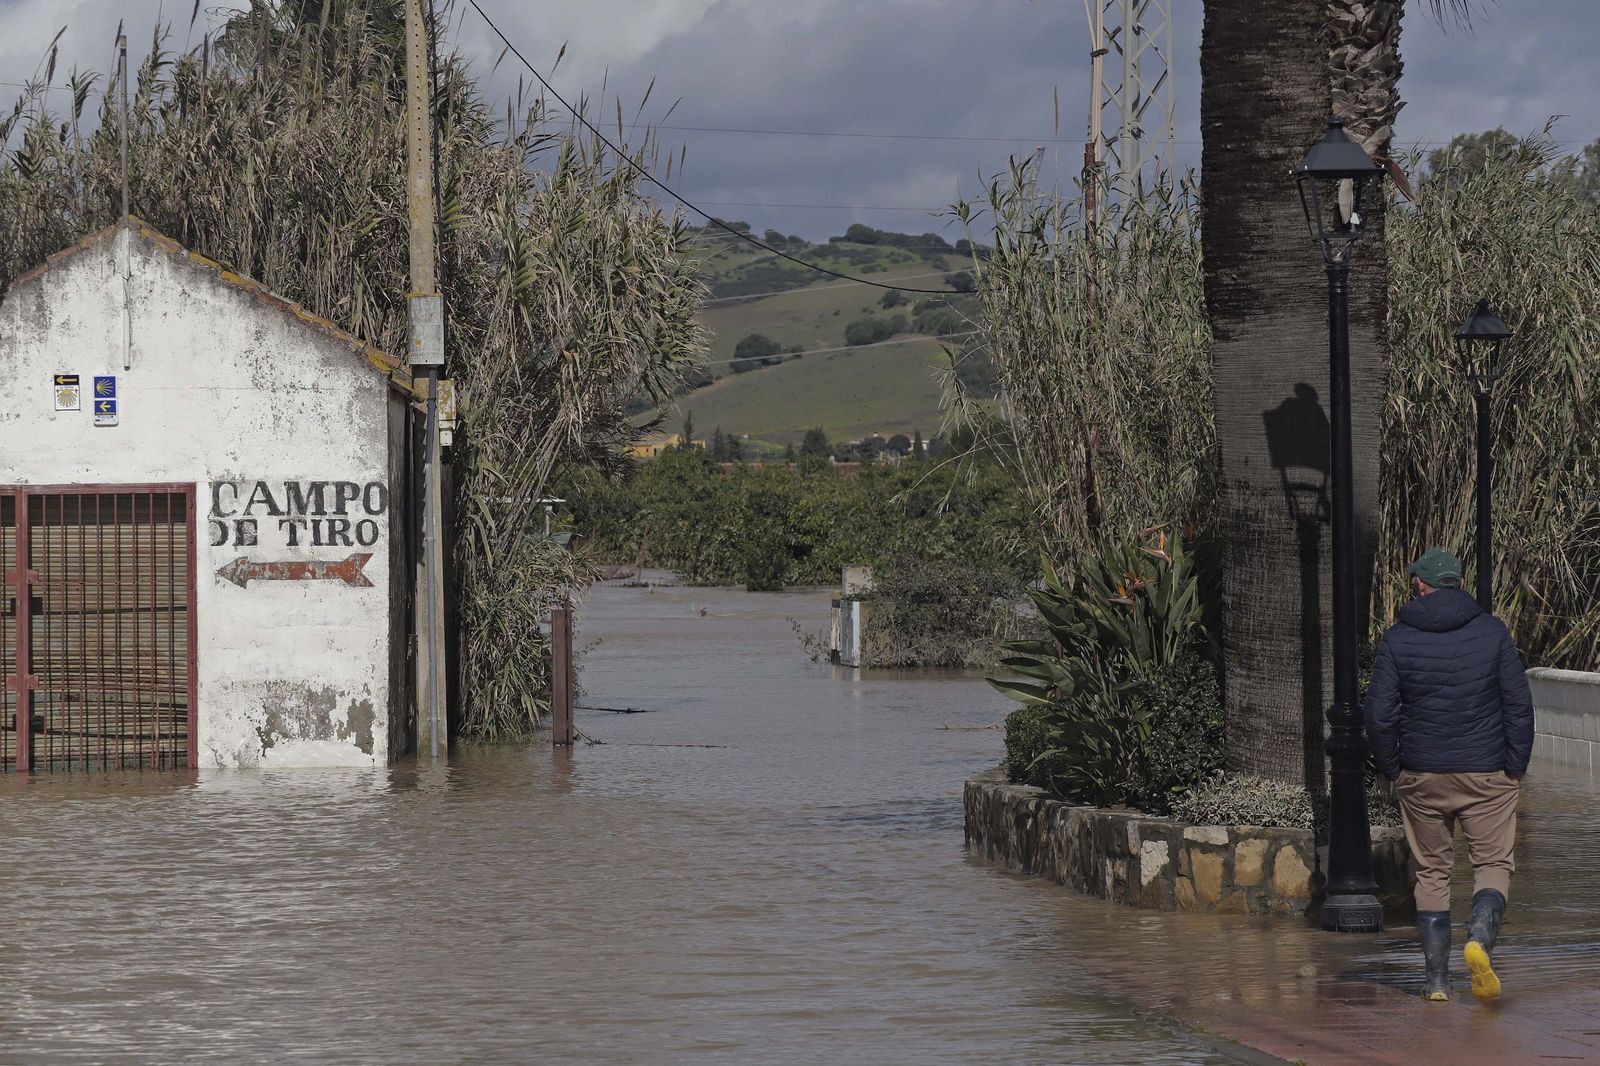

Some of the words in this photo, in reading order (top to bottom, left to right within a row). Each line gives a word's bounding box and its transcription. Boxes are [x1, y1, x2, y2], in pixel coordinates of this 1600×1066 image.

[210, 481, 388, 517] CAMPO
[209, 518, 258, 546] DE
[279, 518, 379, 546] TIRO
